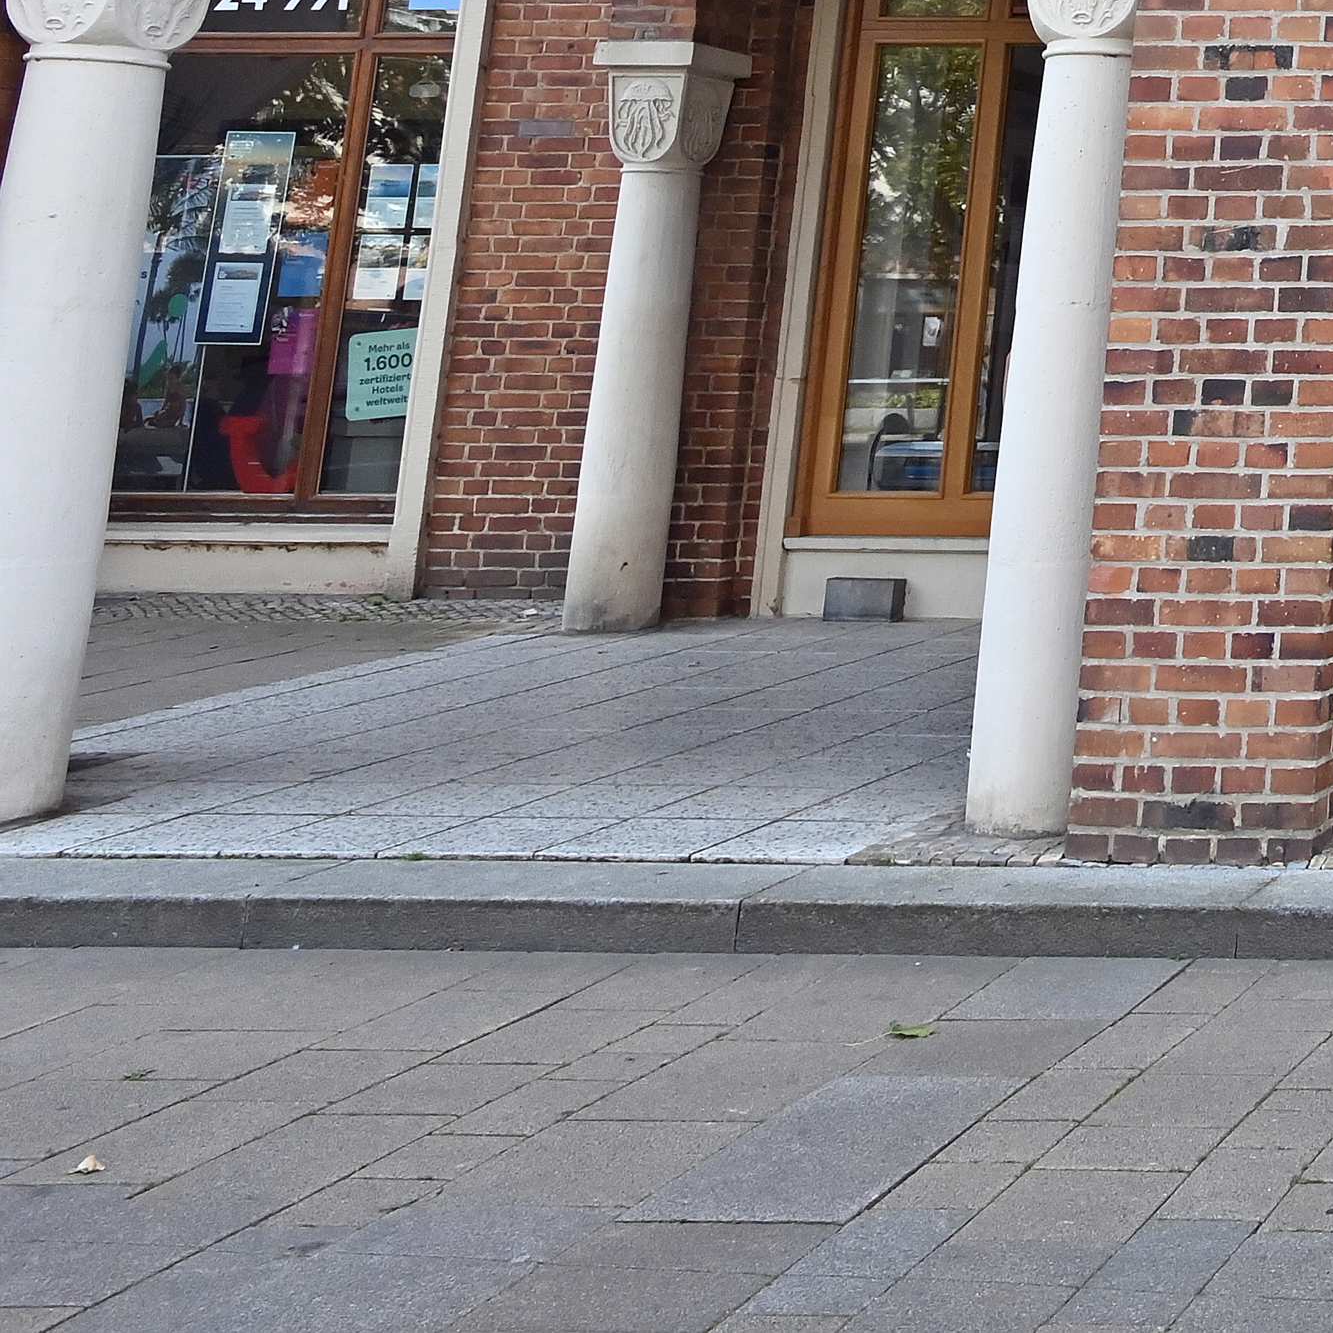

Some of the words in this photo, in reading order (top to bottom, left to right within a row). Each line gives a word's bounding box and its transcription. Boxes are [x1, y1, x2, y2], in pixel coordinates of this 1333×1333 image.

[368, 344, 395, 354] Mehr
[396, 341, 411, 350] als
[363, 352, 413, 372] 1.600
[359, 372, 412, 386] zertifiziert
[371, 383, 404, 395] Hotels
